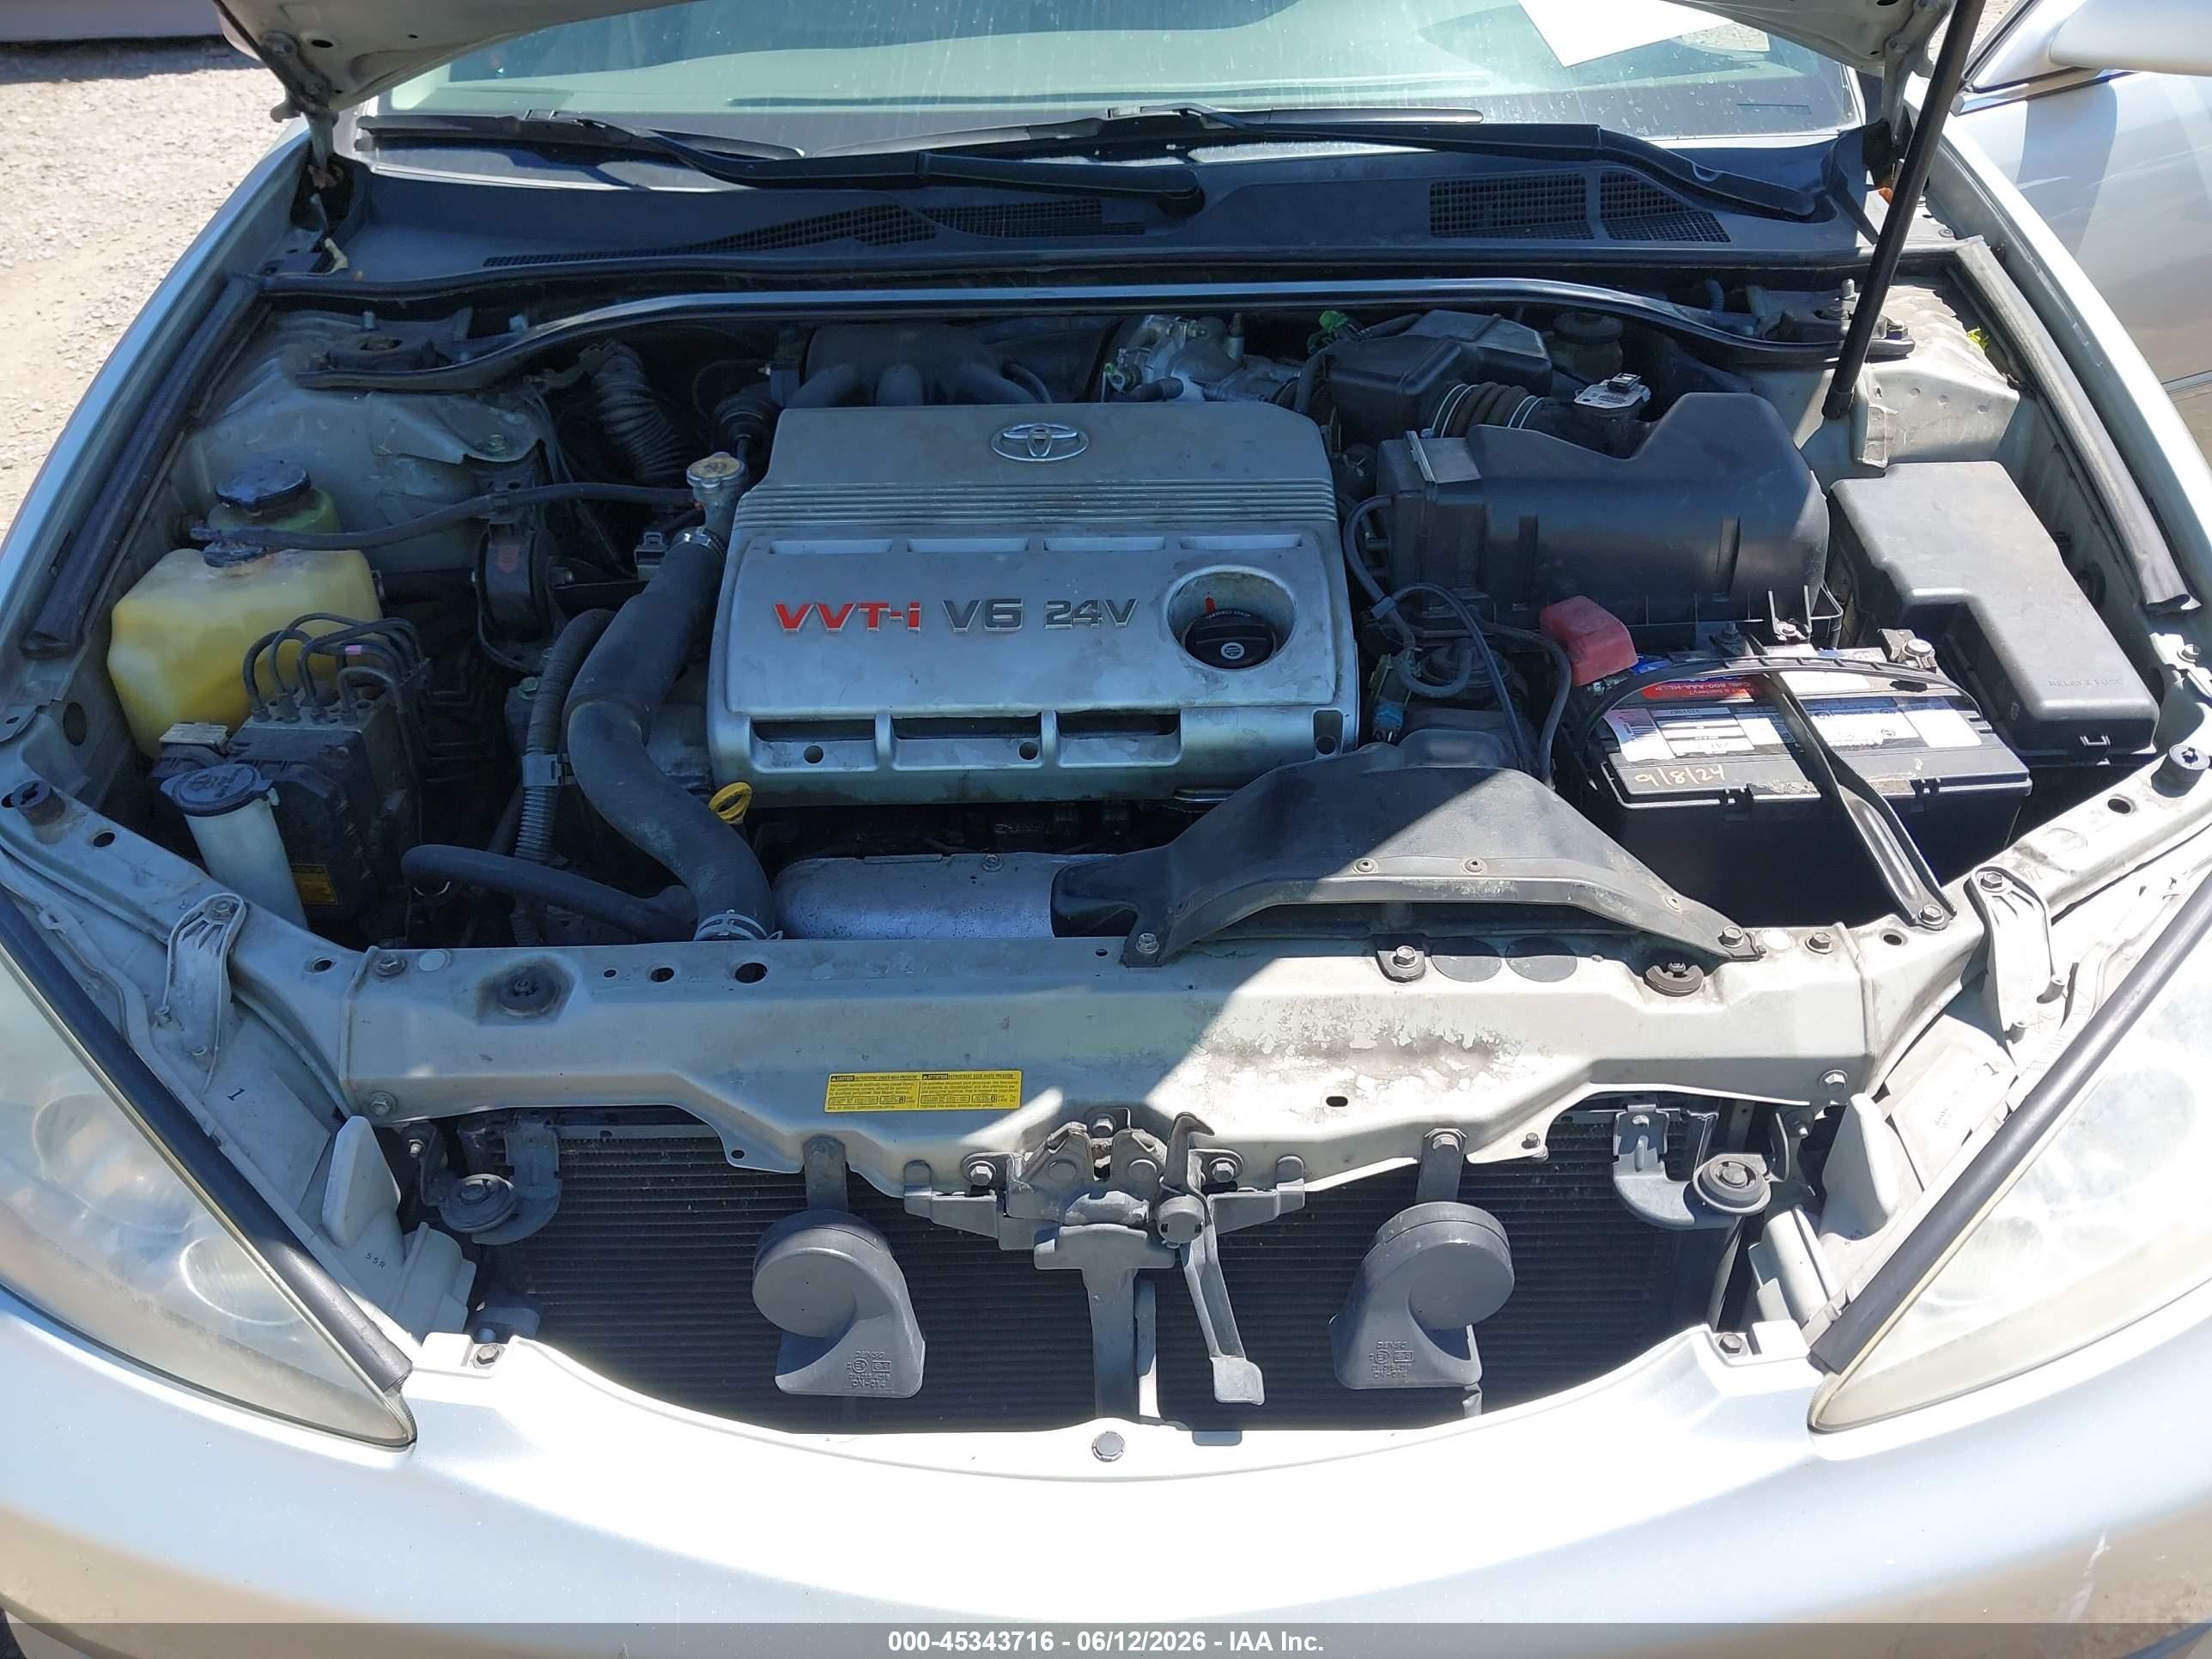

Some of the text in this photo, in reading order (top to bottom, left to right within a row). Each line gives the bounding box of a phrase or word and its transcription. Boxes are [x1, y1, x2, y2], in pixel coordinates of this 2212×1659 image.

[774, 598, 1139, 632] VVT-i V6 24V
[1634, 765, 1725, 787] 9/8/24
[1376, 1340, 1407, 1349] DENSO
